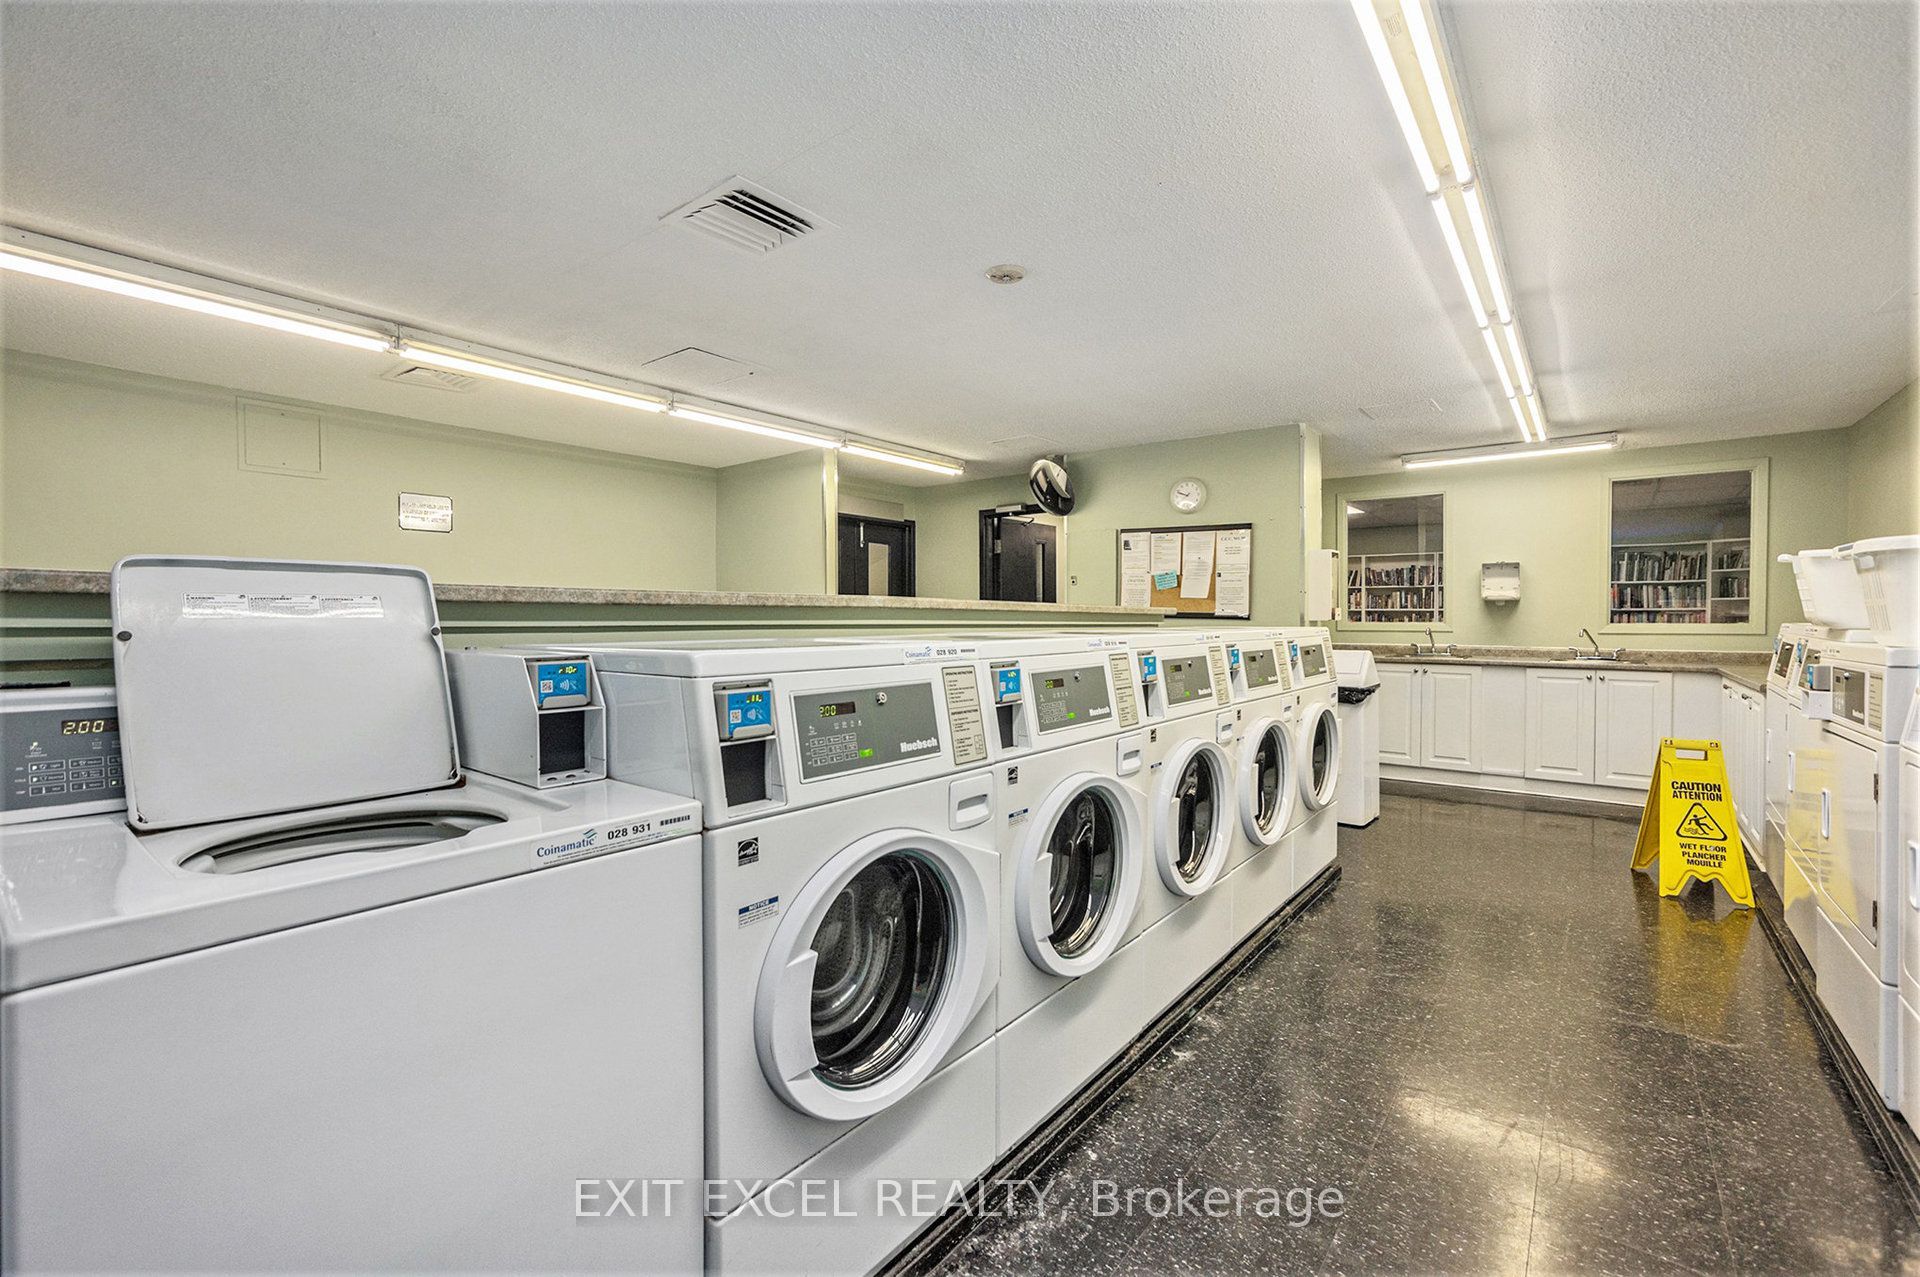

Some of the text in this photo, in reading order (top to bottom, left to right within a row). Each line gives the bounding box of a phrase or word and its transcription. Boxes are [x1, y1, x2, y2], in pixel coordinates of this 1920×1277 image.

[63, 720, 105, 735] 2.00
[900, 737, 938, 752] Huebsch
[1671, 780, 1721, 792] CAUTION
[1672, 790, 1722, 802] ATTENTION
[536, 823, 651, 858] Coinamatic 028 931
[1681, 851, 1726, 862] PLANCHER
